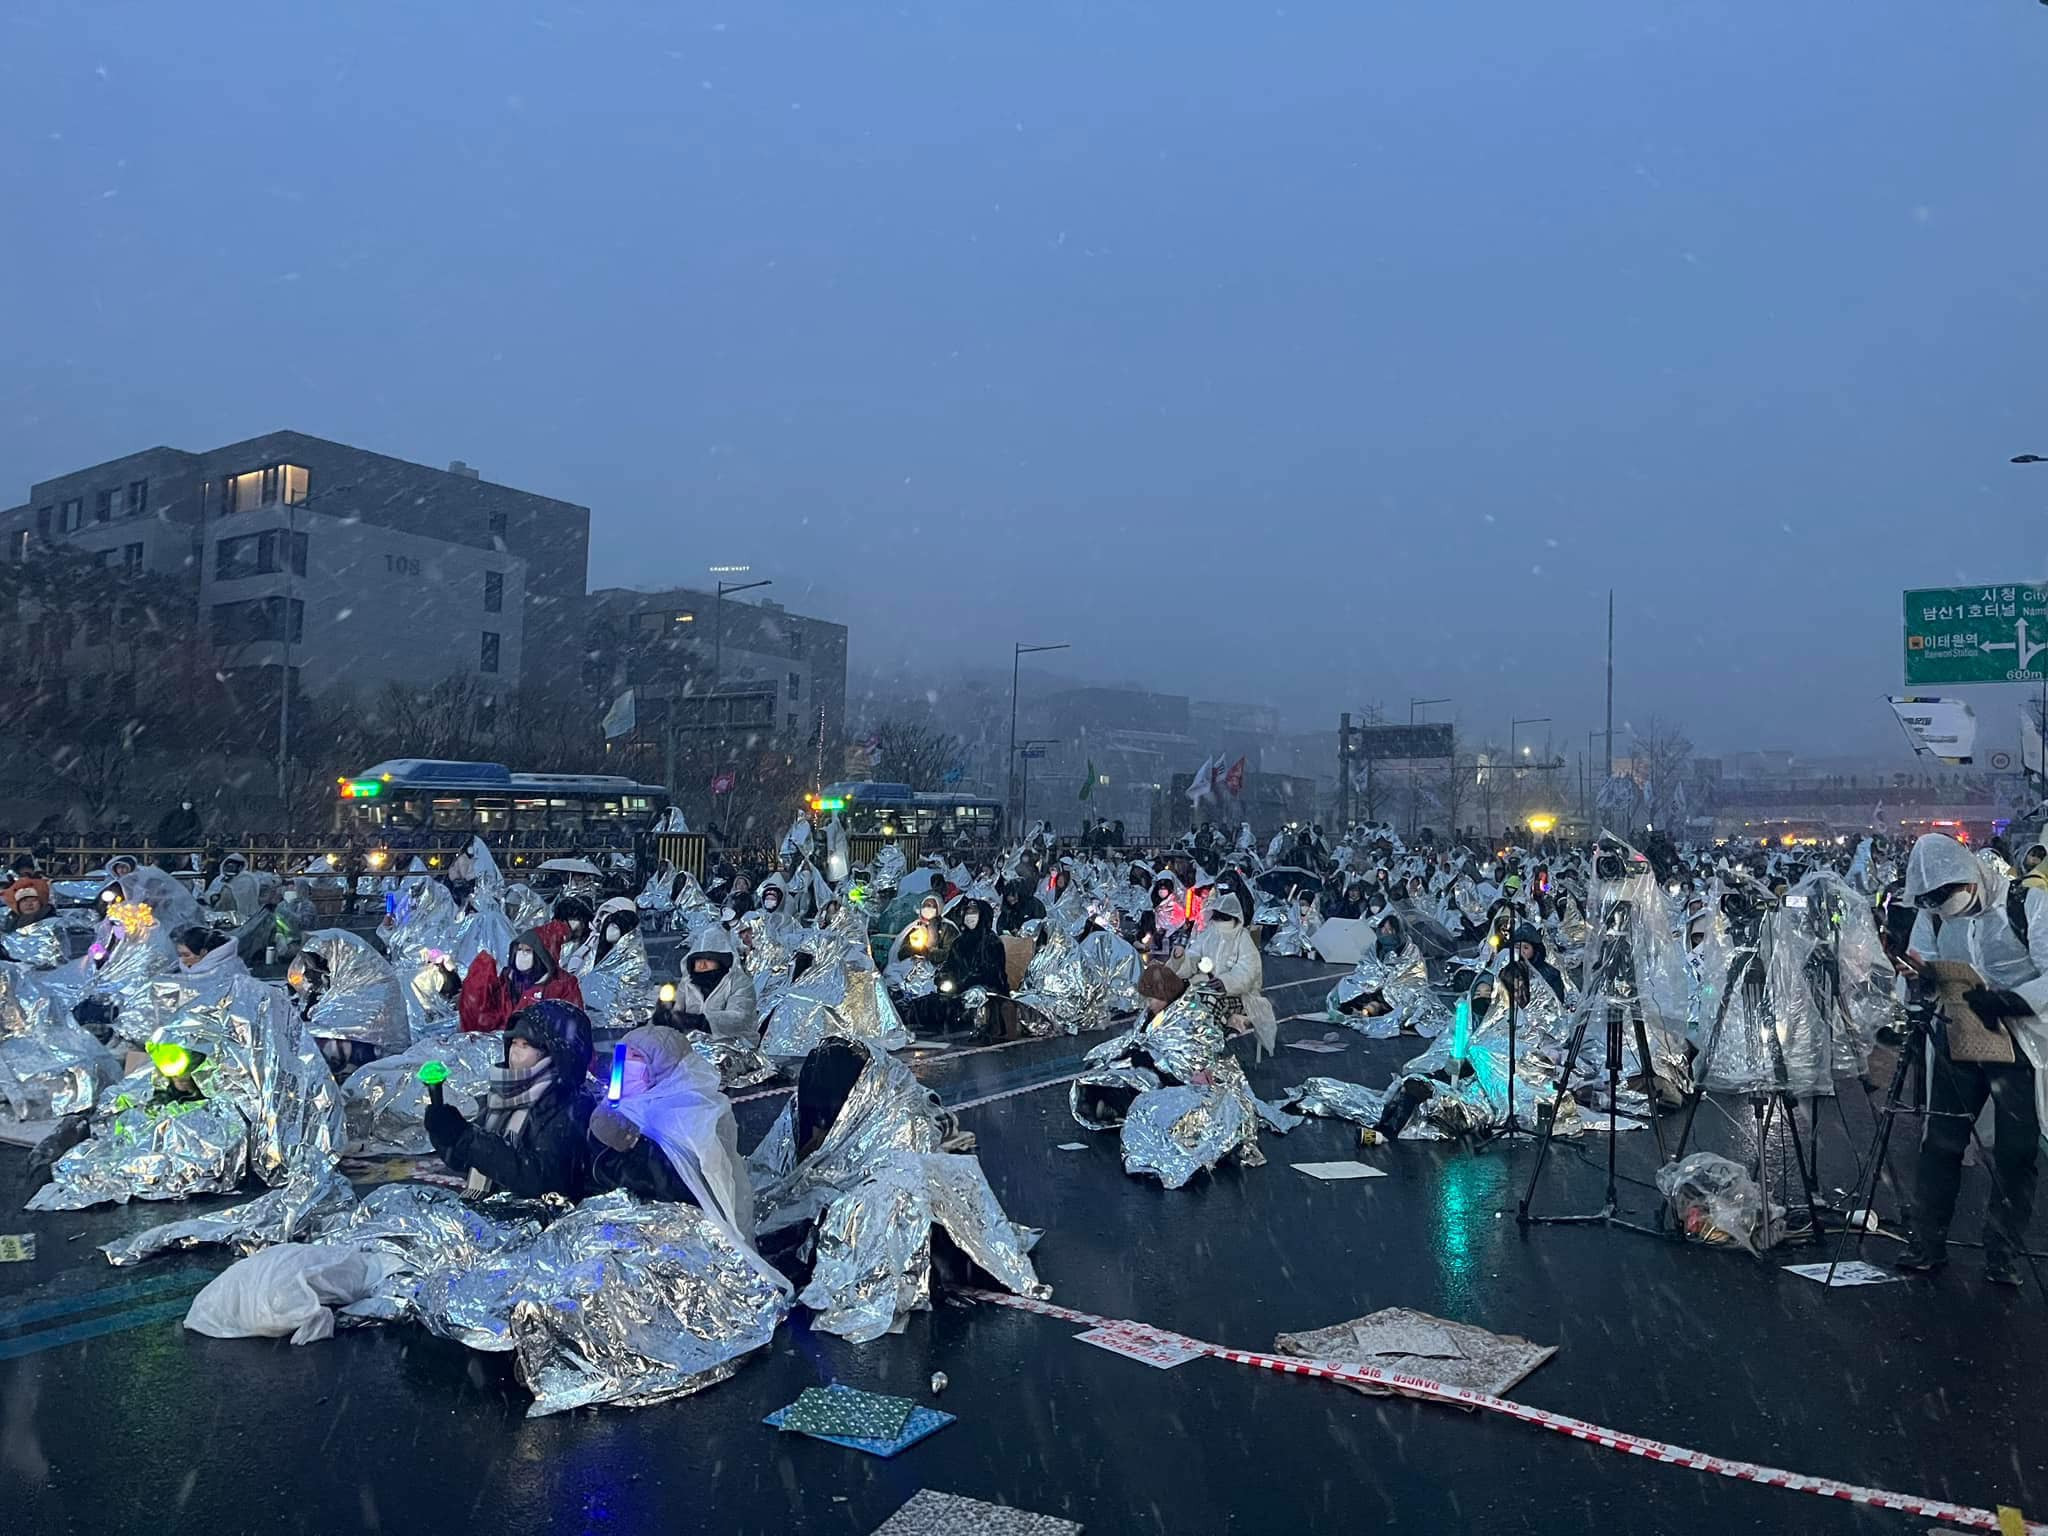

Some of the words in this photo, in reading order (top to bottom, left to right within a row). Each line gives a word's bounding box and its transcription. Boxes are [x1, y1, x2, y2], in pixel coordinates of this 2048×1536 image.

[1981, 587, 2016, 602] 시청
[1923, 602, 2016, 621] 남산1호터널
[1924, 633, 1978, 649] 이태원역
[2006, 670, 2043, 681] 600m
